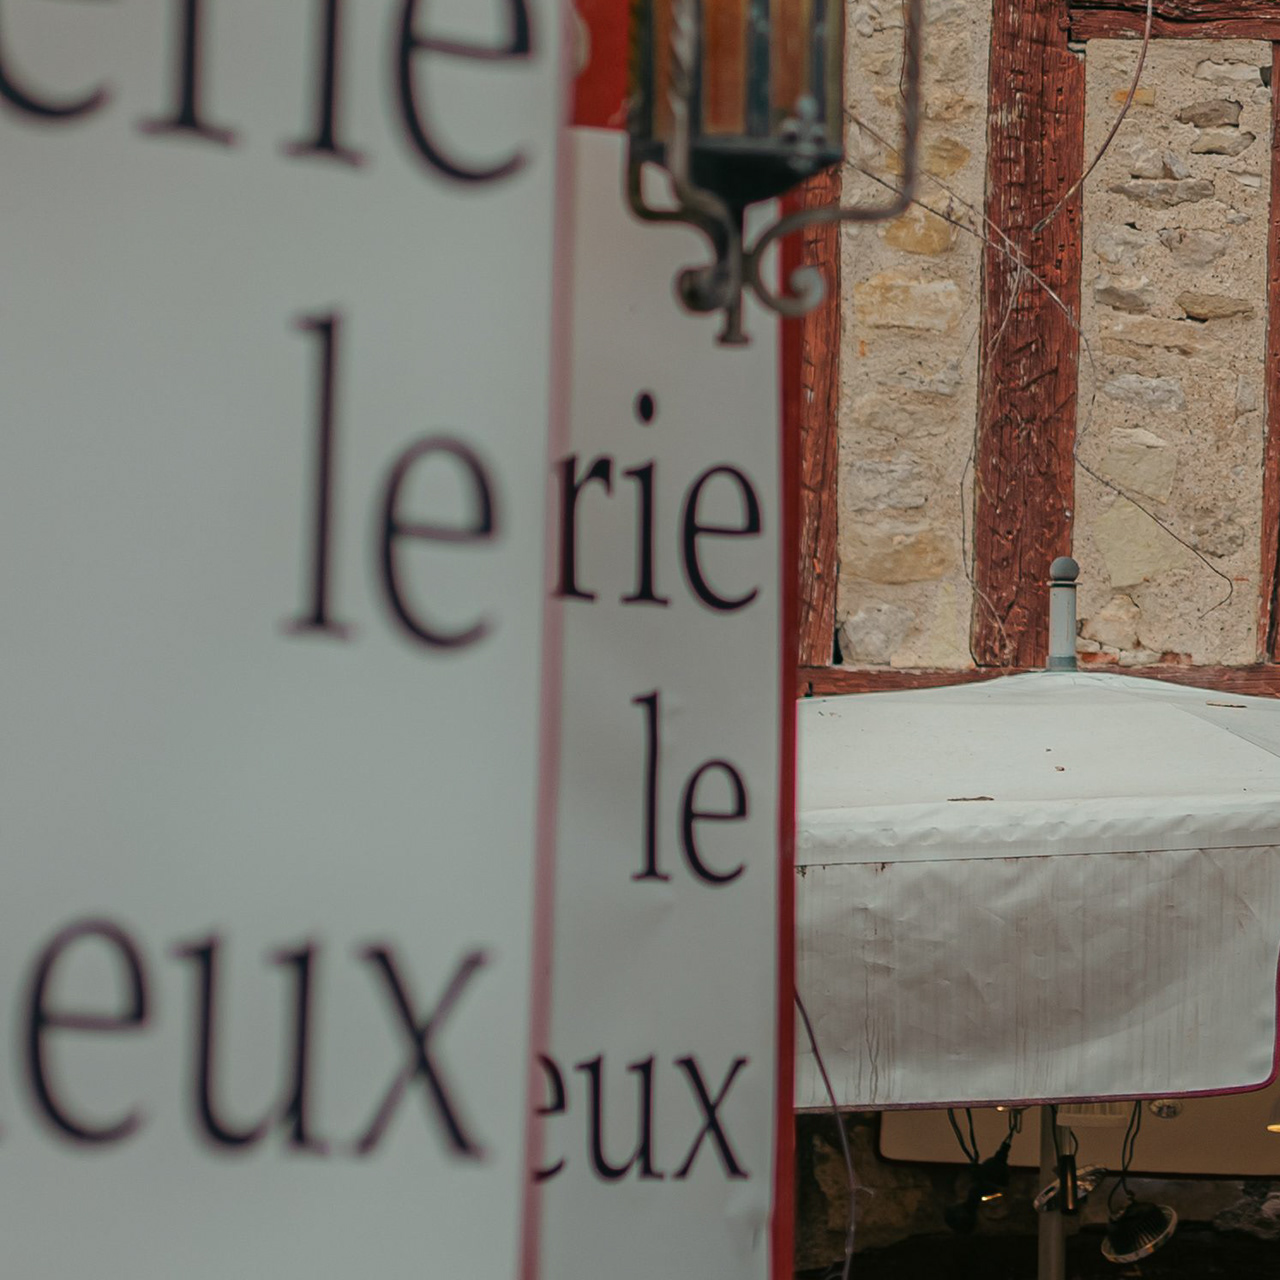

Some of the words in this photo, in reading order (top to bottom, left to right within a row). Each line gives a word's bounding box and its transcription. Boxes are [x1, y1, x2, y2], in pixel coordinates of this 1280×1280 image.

[286, 308, 498, 652] le
[550, 390, 763, 612] rie
[630, 688, 748, 888] le
[0, 914, 490, 1162] eux
